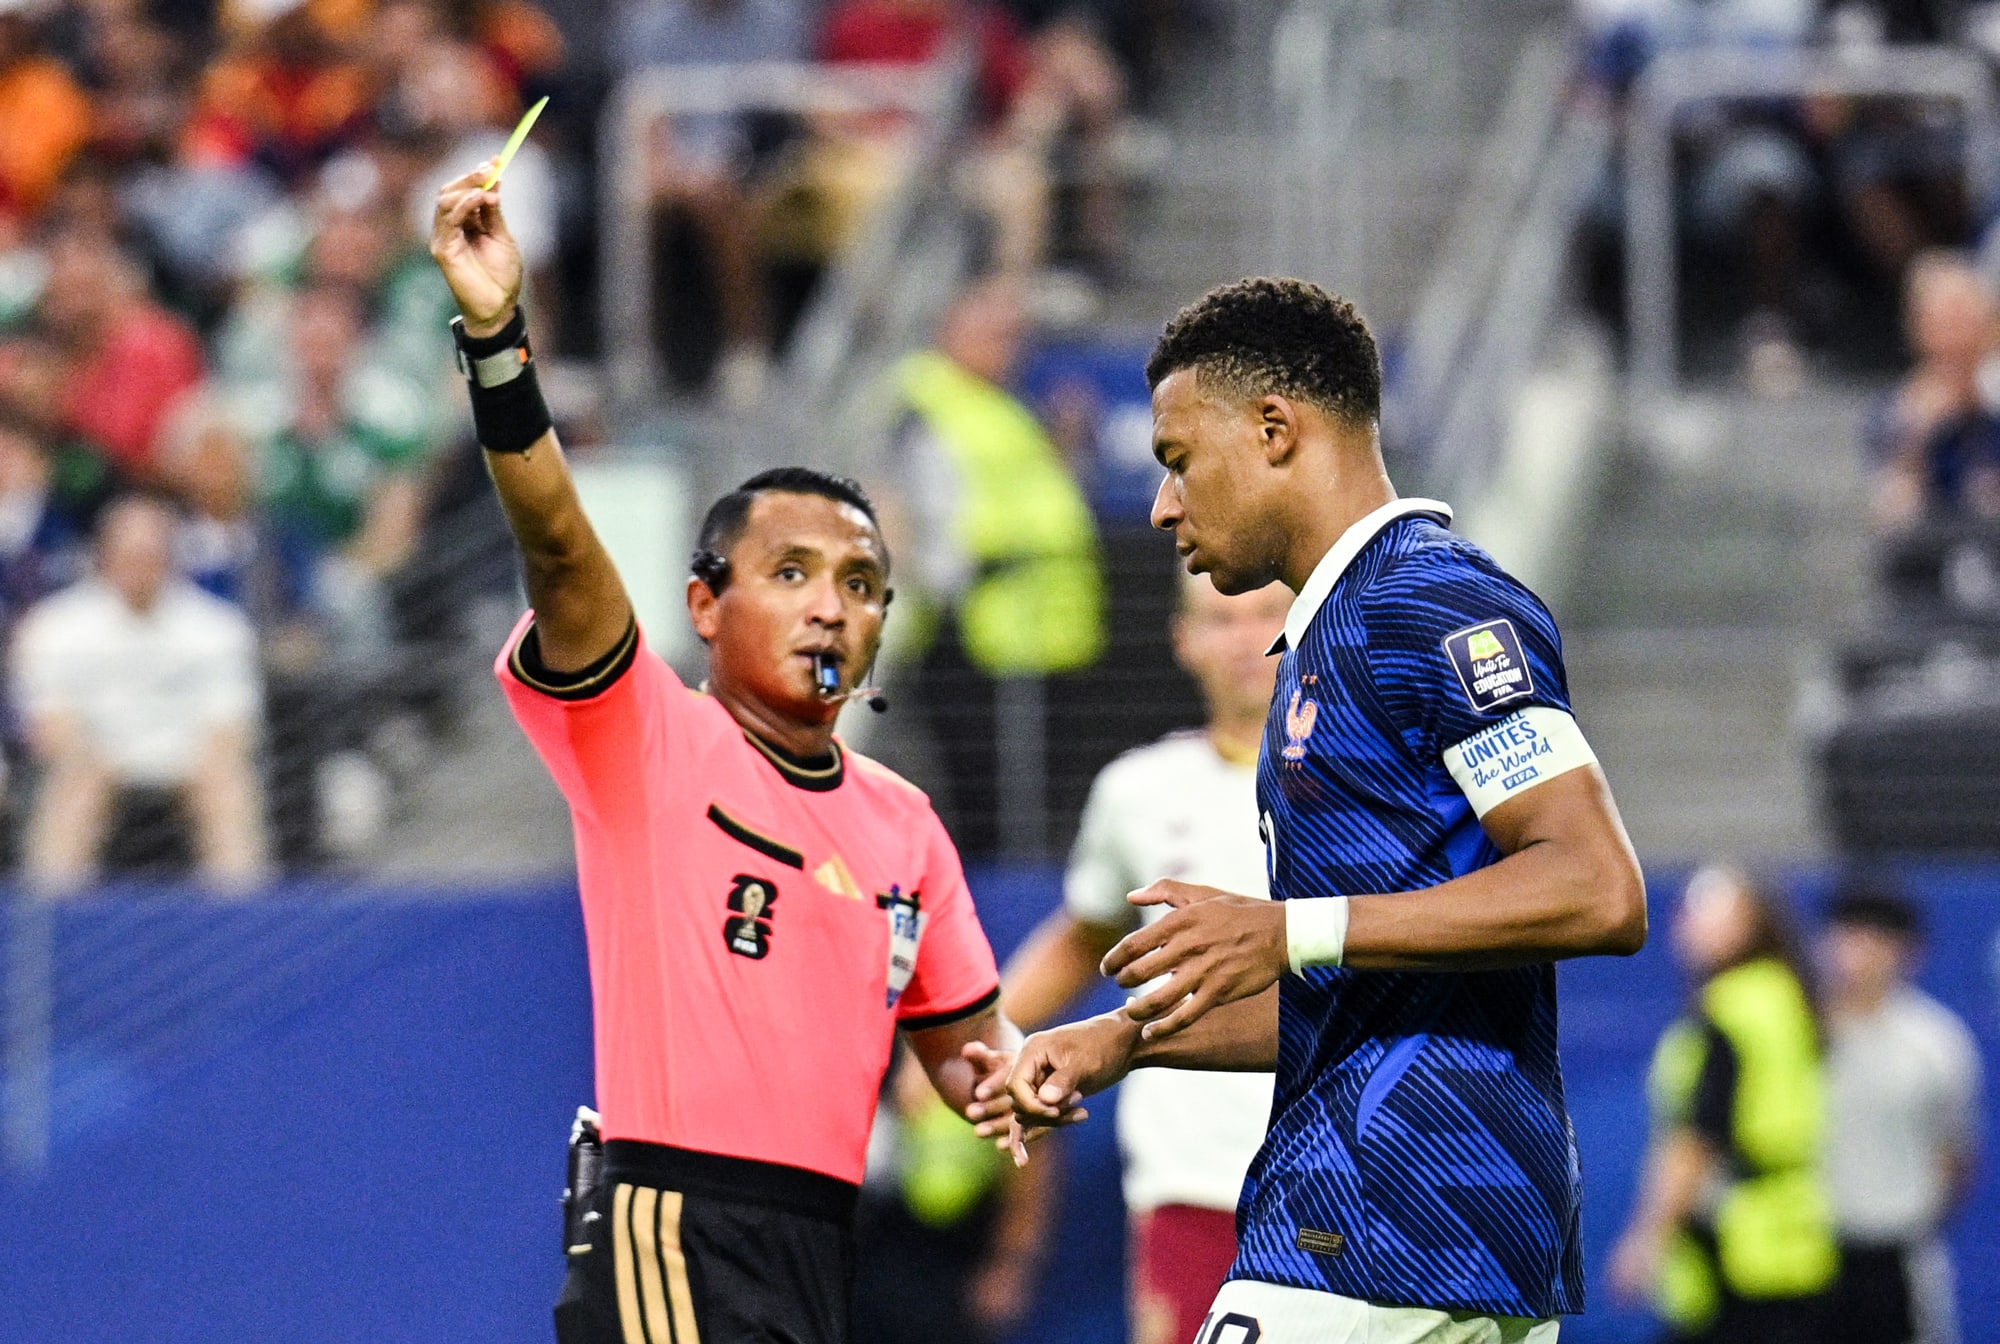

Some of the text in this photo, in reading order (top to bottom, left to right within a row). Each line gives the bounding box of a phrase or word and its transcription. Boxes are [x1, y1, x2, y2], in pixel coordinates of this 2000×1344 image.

[1495, 654, 1510, 671] For
[1473, 667, 1522, 695] EDUCATION
[1493, 684, 1513, 698] FIFA
[1462, 721, 1537, 769] UNITES
[1472, 737, 1553, 788] the World
[1502, 766, 1539, 790] FIFA
